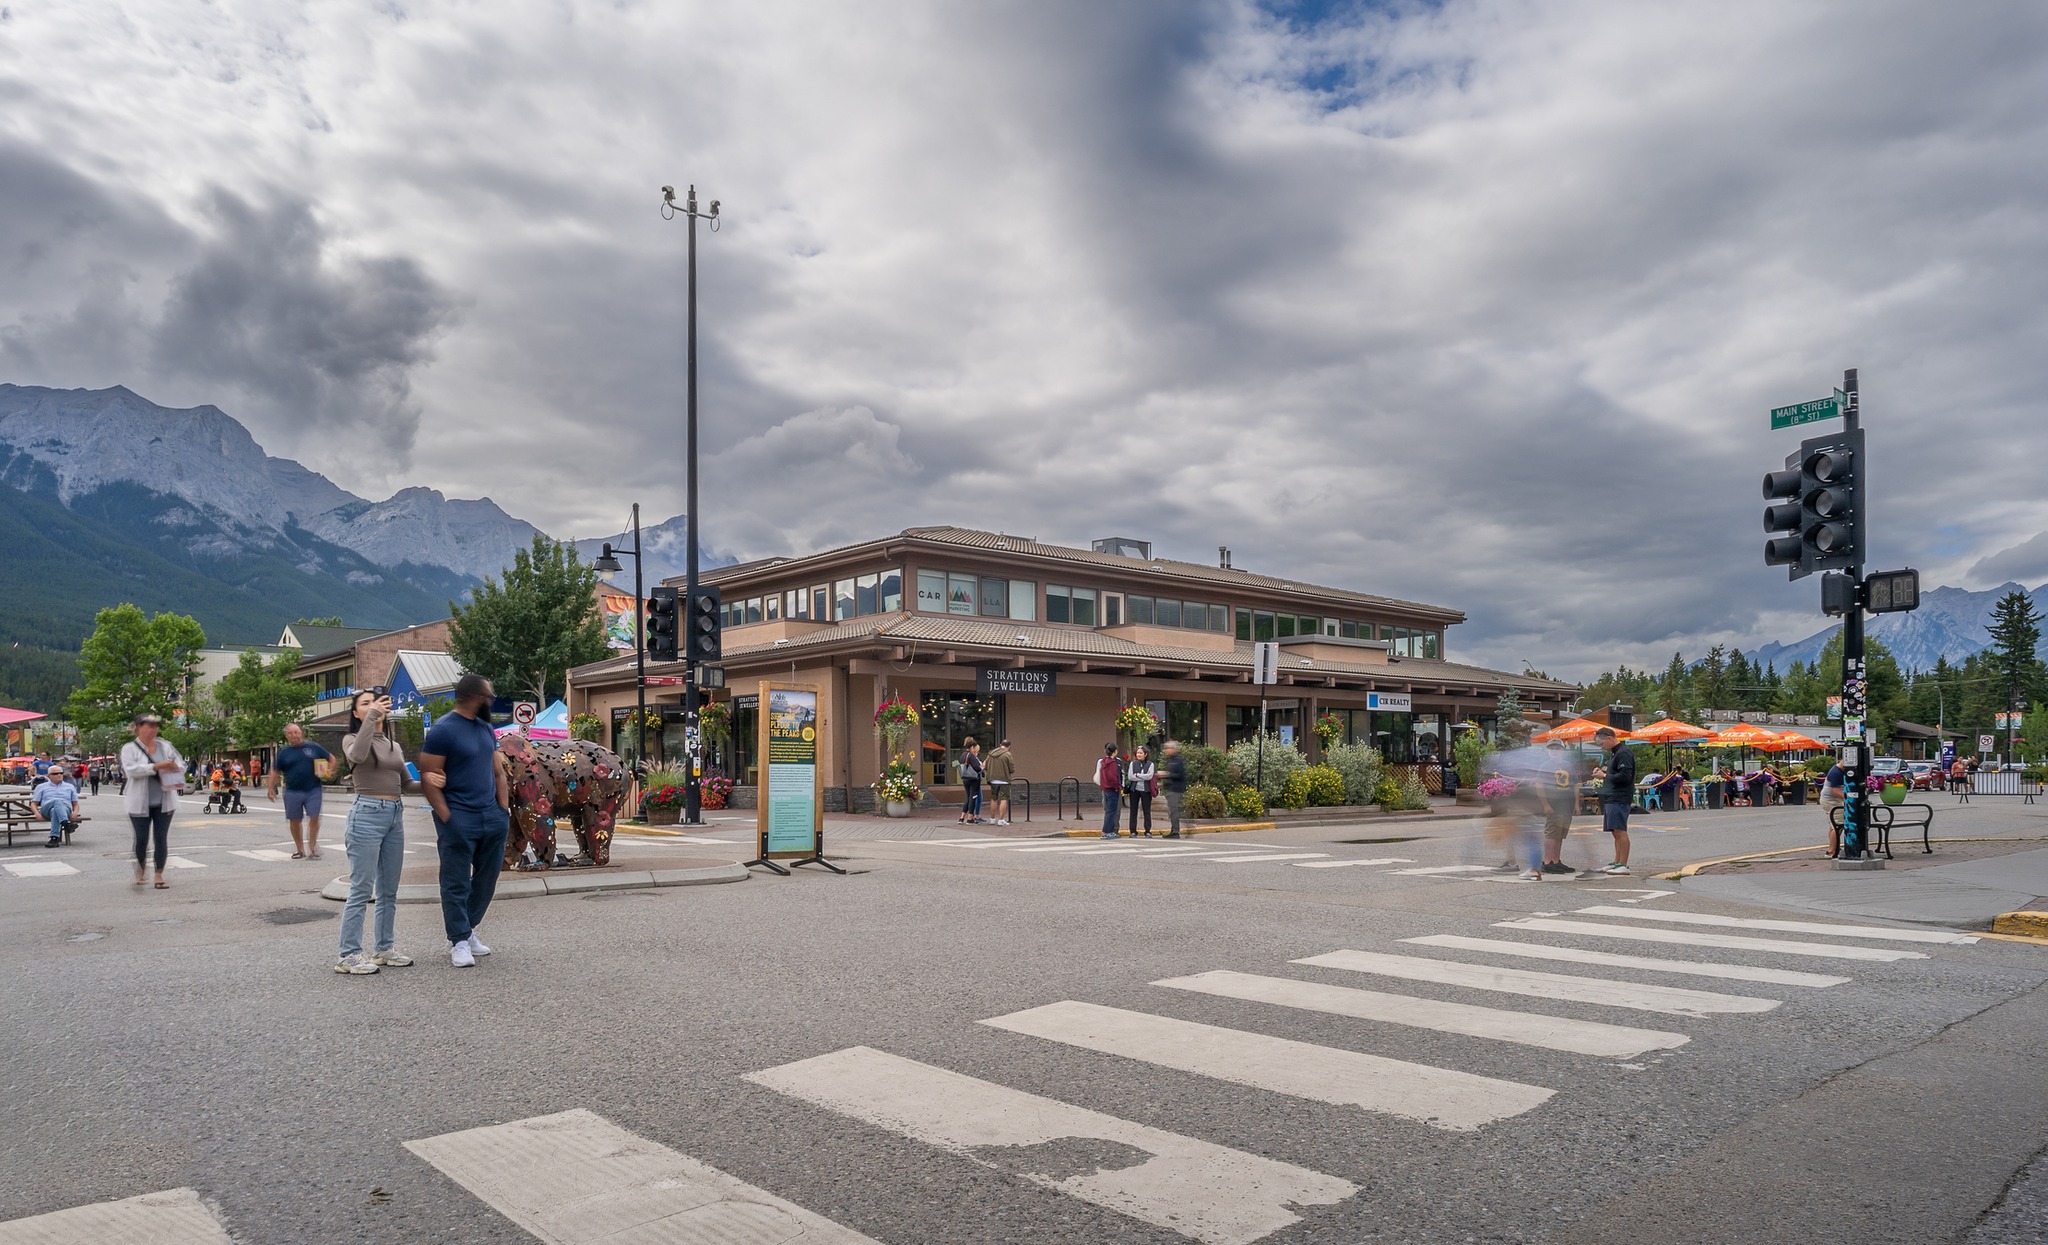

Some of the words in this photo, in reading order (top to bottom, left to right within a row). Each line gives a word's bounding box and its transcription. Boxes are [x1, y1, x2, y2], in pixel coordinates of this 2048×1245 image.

[1776, 406, 1798, 418] MAIN
[1801, 400, 1834, 413] STREET
[1807, 411, 1820, 421] ST)
[918, 590, 941, 600] CAR
[986, 670, 1049, 682] STRATTON'S
[989, 681, 1046, 693] JEWELLERY
[1379, 697, 1388, 705] CIR
[1390, 698, 1409, 706] REALTY
[771, 729, 781, 737] THE
[1548, 726, 1586, 735] VIZZY
